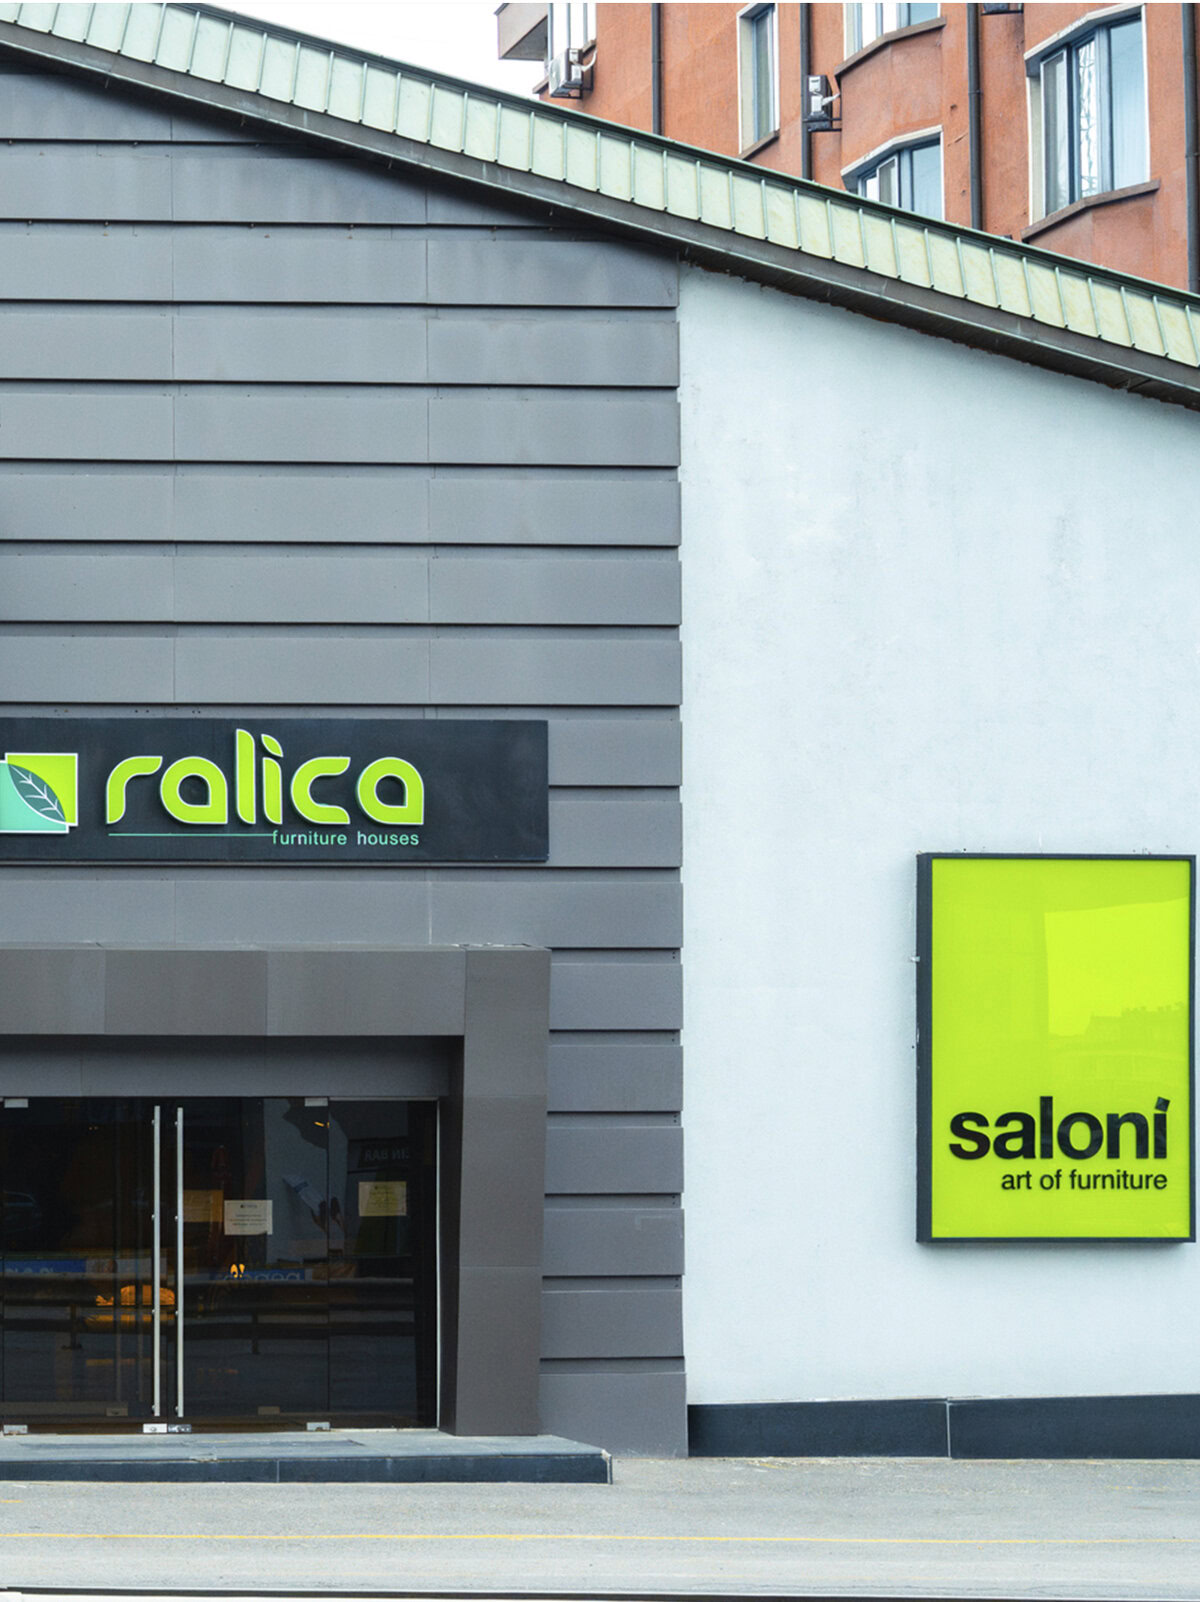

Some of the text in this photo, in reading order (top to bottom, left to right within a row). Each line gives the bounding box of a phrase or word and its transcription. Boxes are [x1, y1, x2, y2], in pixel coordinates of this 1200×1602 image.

[105, 728, 425, 826] ralica
[271, 829, 420, 846] furniture houses
[948, 1095, 1171, 1161] saloni
[1001, 1168, 1168, 1191] art of furniture
